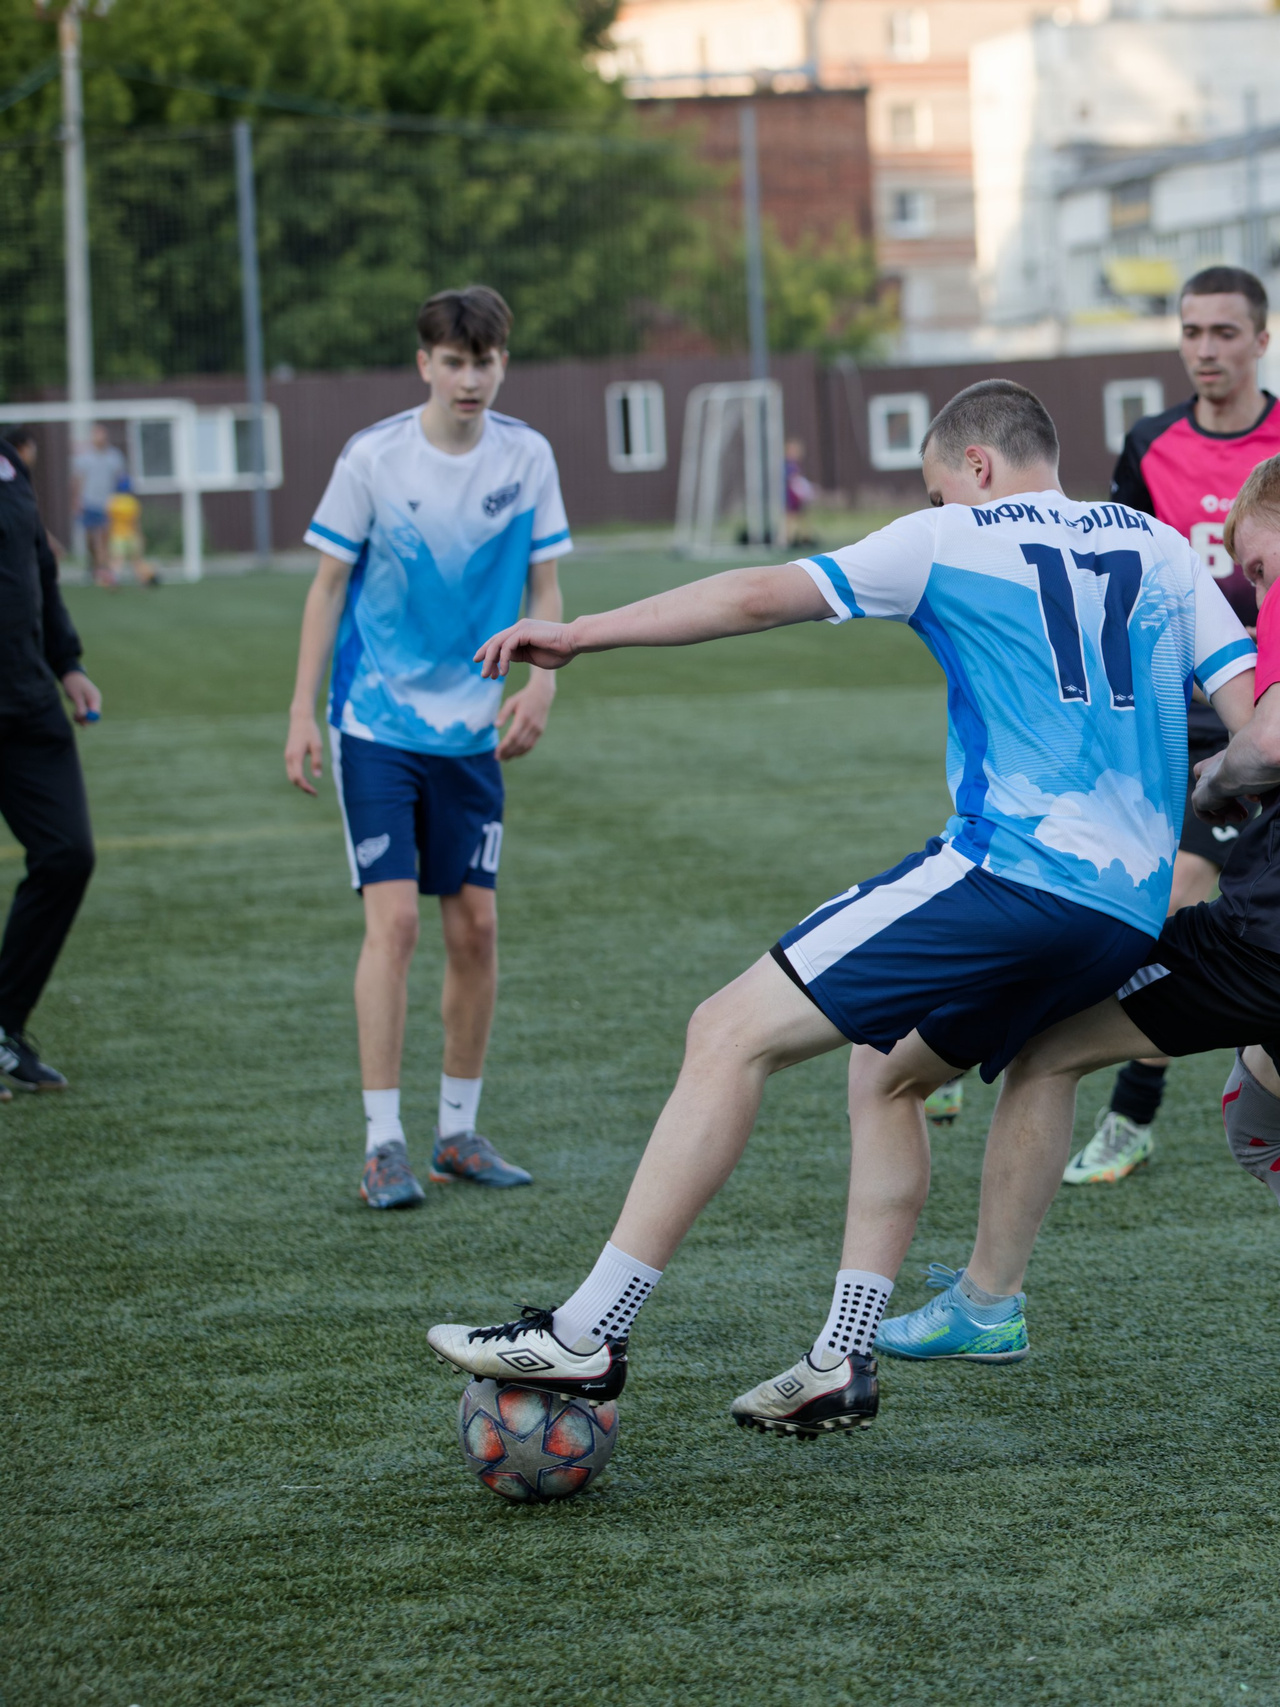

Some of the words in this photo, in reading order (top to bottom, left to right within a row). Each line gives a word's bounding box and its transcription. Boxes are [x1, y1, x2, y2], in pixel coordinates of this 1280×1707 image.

[970, 502, 1046, 527] МФК
[1190, 522, 1234, 579] 6
[1018, 542, 1144, 712] 17
[468, 820, 504, 874] 10
